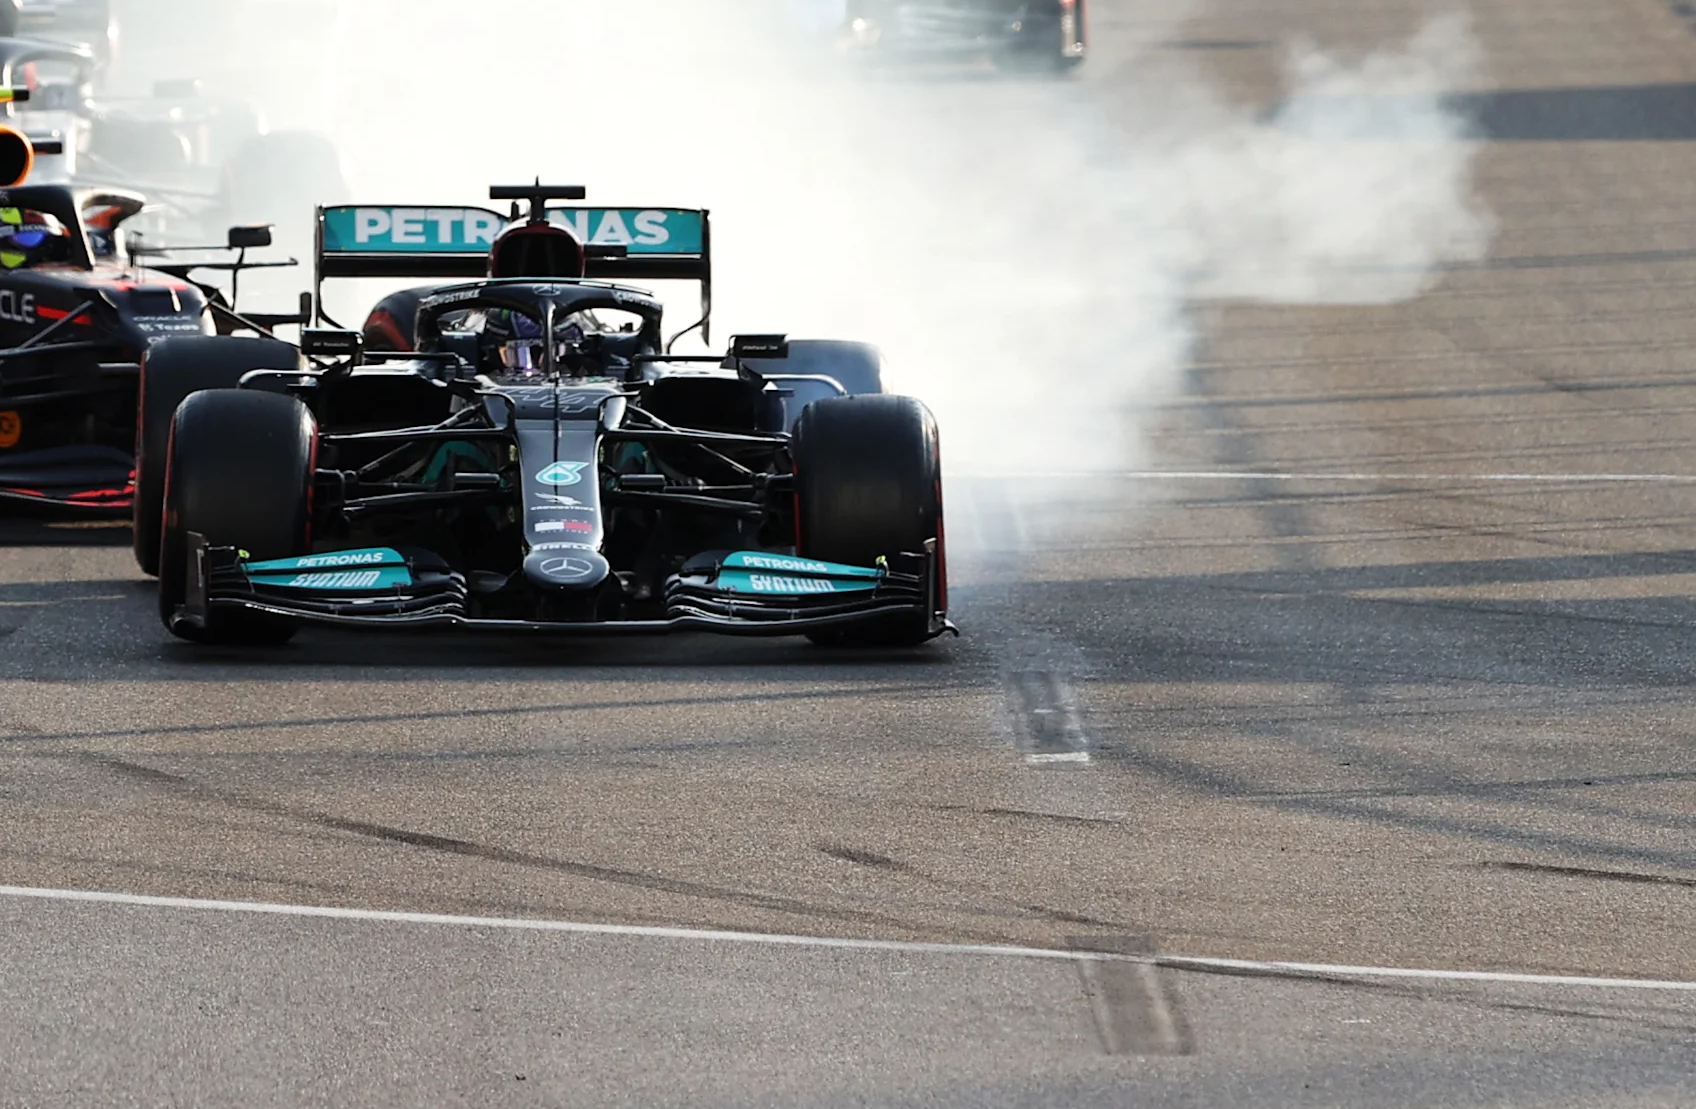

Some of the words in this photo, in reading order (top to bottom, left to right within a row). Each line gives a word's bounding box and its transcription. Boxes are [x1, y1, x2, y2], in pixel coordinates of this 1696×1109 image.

[354, 208, 670, 246] PETRNAS
[296, 552, 384, 568] PETRONAS
[742, 555, 828, 573] PETRONAS
[289, 571, 382, 587] SYNTIUM
[749, 574, 837, 592] SYNTIUM
